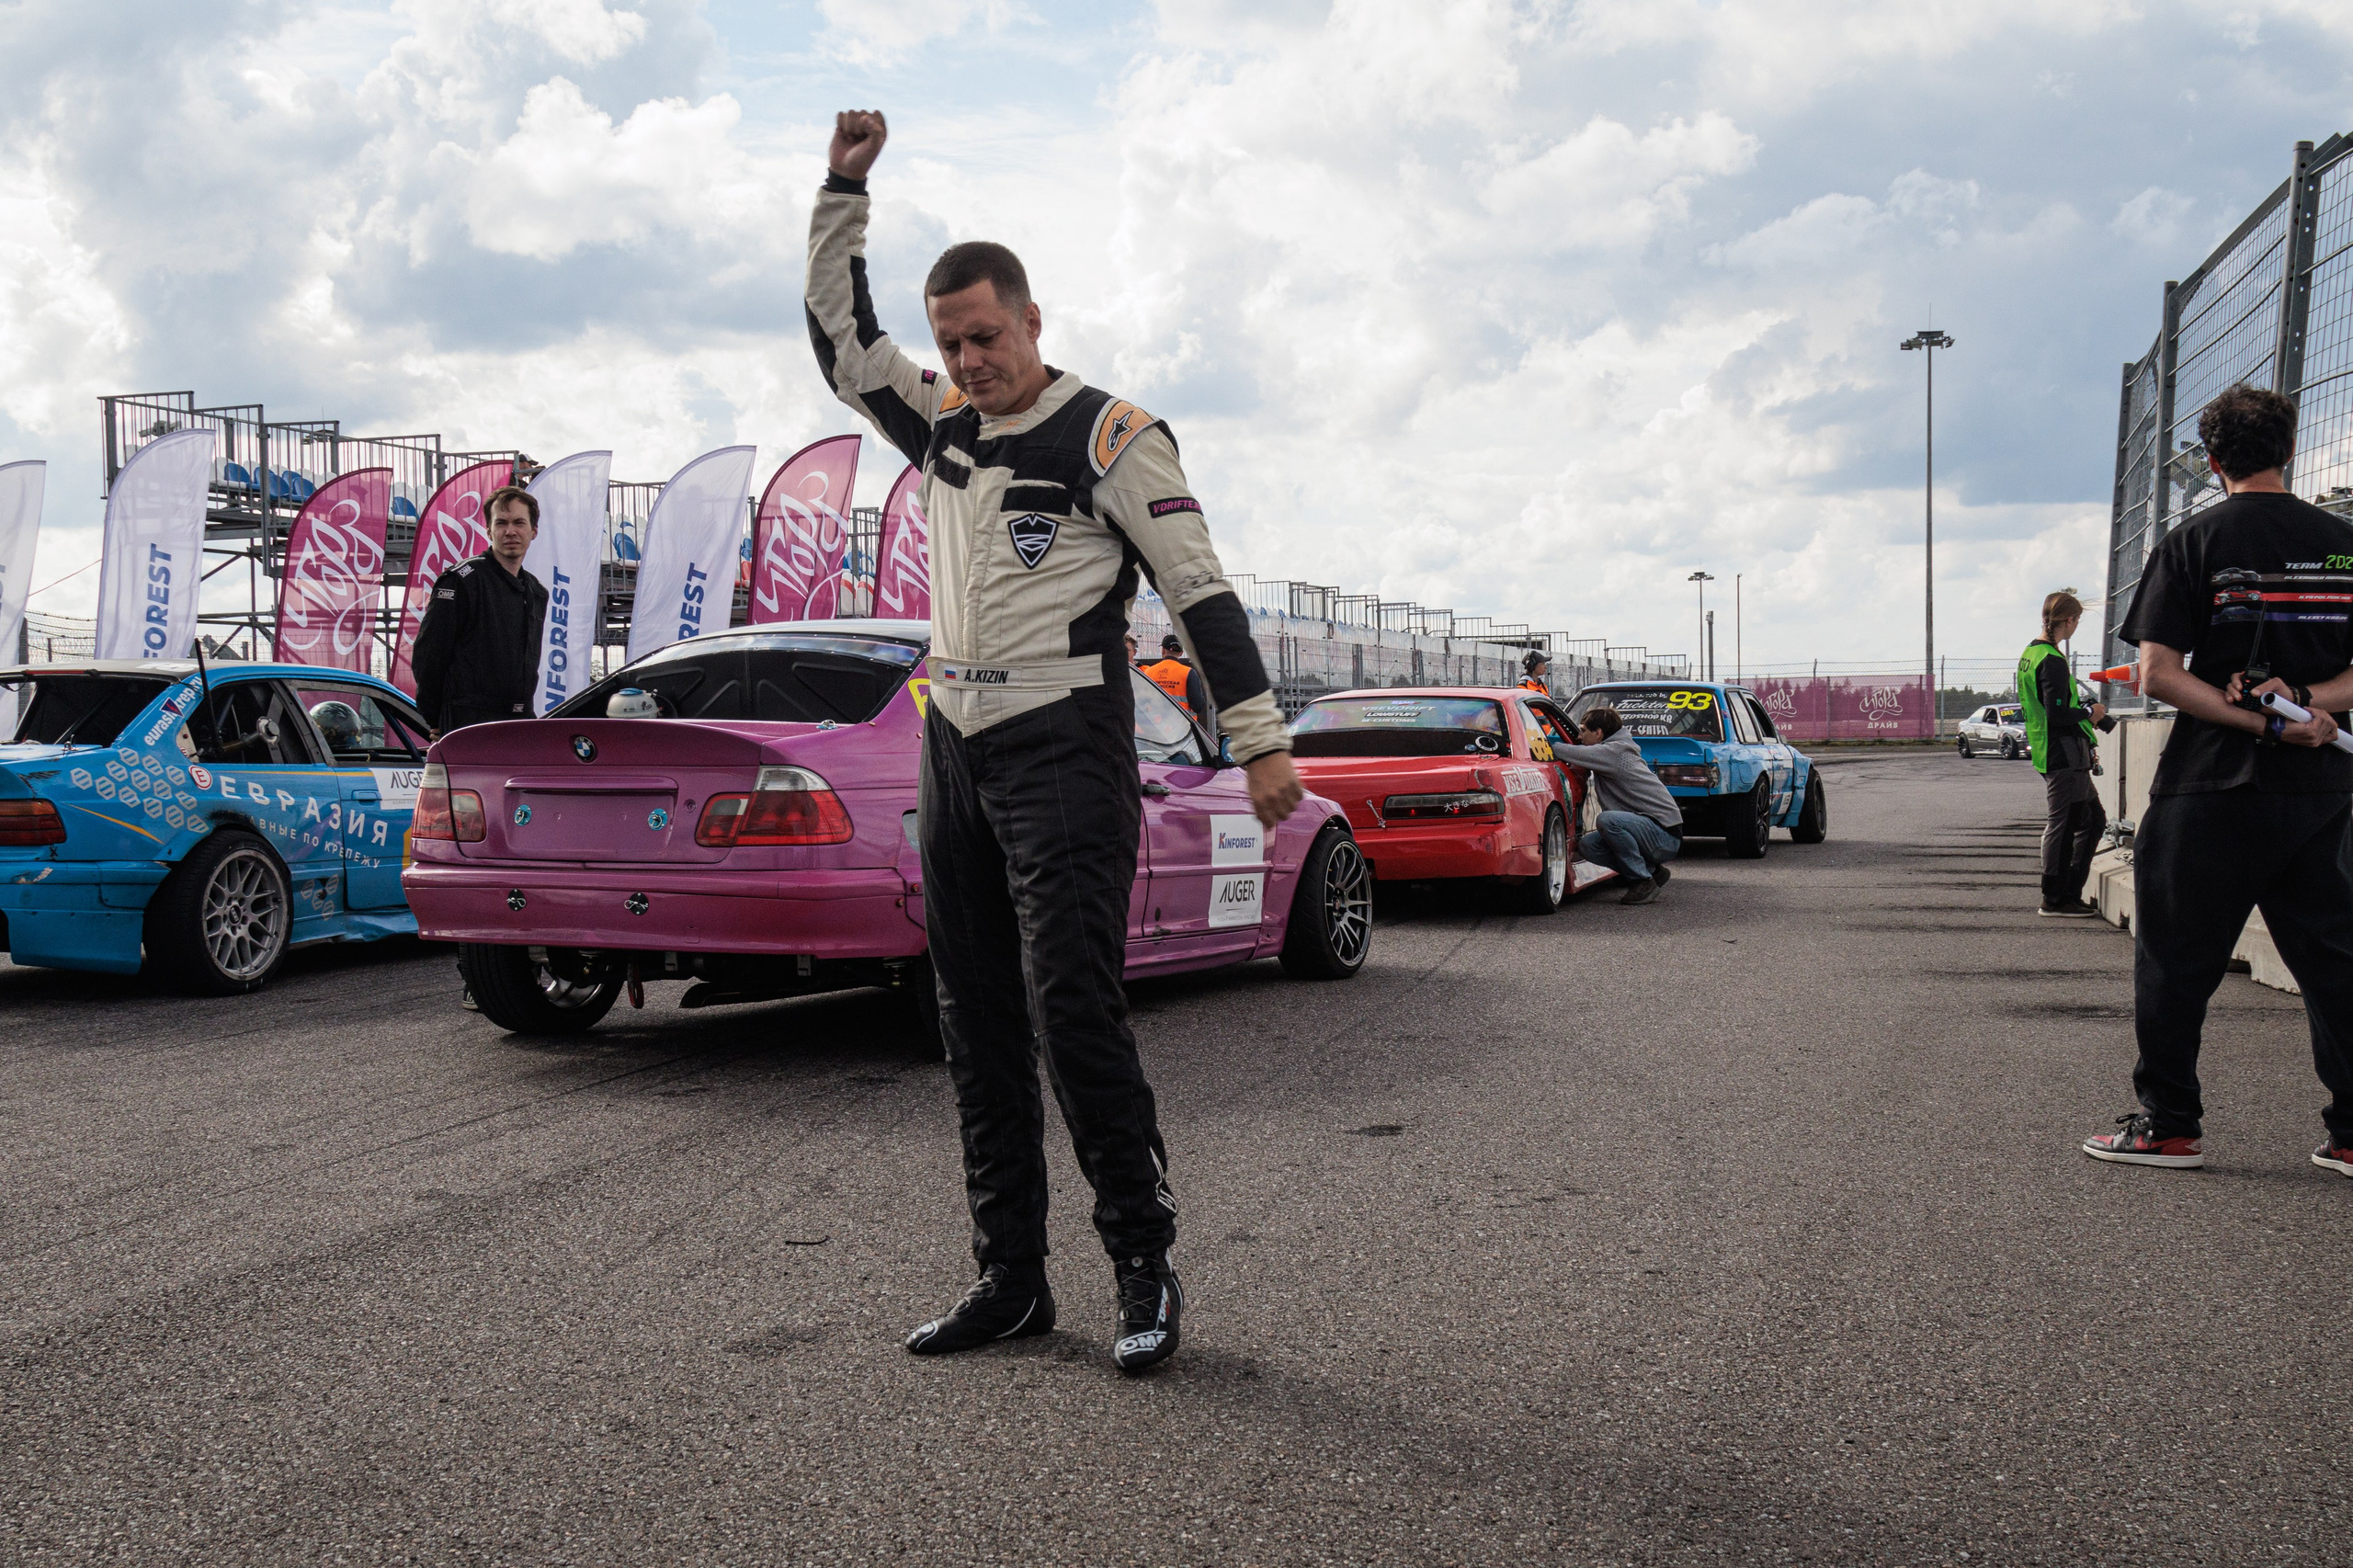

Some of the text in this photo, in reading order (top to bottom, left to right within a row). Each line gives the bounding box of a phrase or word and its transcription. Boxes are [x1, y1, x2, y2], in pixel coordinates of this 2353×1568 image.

[438, 589, 455, 598] OMP
[964, 669, 1009, 684] A.KIZIN
[1667, 691, 1712, 710] 93
[220, 776, 388, 847] ЕВРАЗИЯ
[1218, 832, 1256, 849] KINFOREST
[303, 833, 319, 846] ПО
[324, 841, 381, 869] КРЕПЕЖУ
[1219, 880, 1256, 903] AUGER
